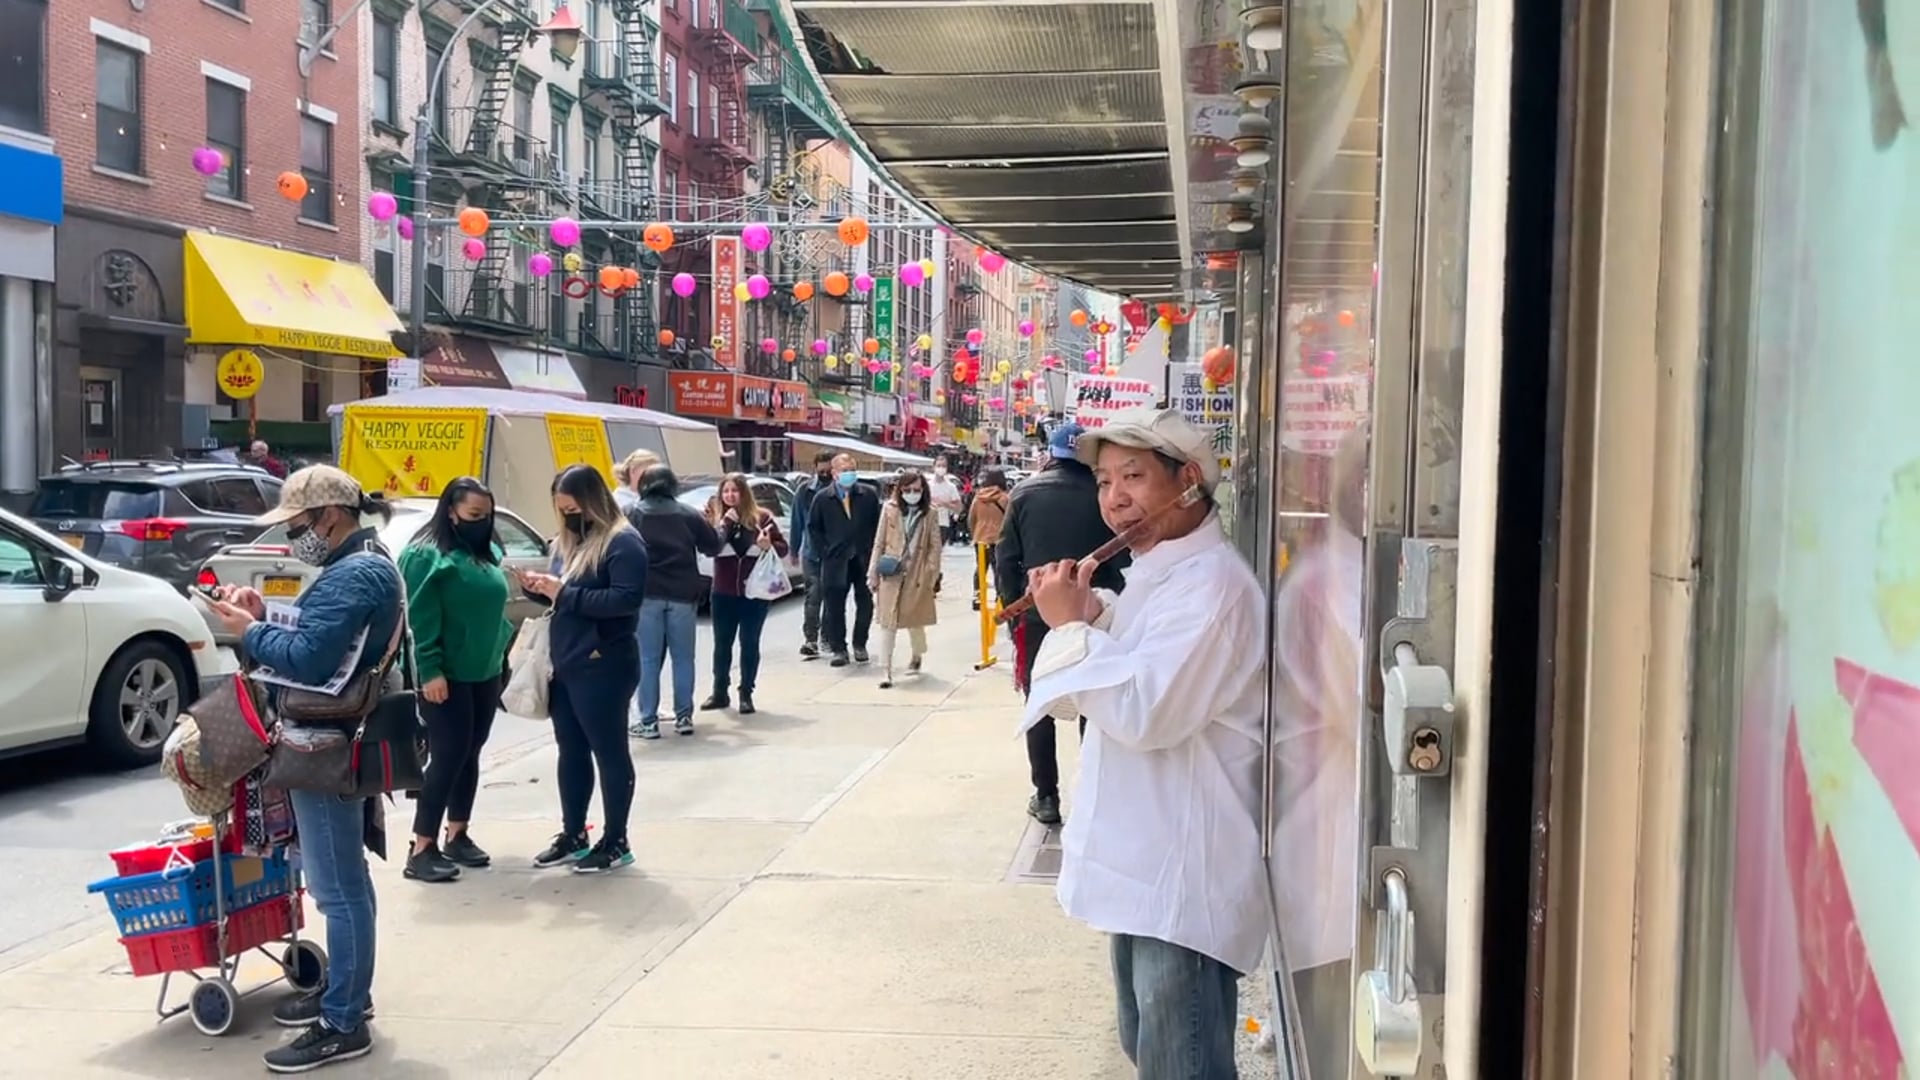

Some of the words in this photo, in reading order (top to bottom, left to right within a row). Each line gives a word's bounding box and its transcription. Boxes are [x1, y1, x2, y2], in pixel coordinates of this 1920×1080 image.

[278, 330, 310, 346] HAPPY
[313, 334, 342, 350] VEGGIE
[742, 386, 770, 408] CANTON
[782, 391, 805, 409] LOUNGE
[362, 421, 410, 438] HAPPY
[417, 421, 464, 439] VEGGIE
[1075, 416, 1109, 428] WA
[365, 439, 460, 450] RESTAURANT
